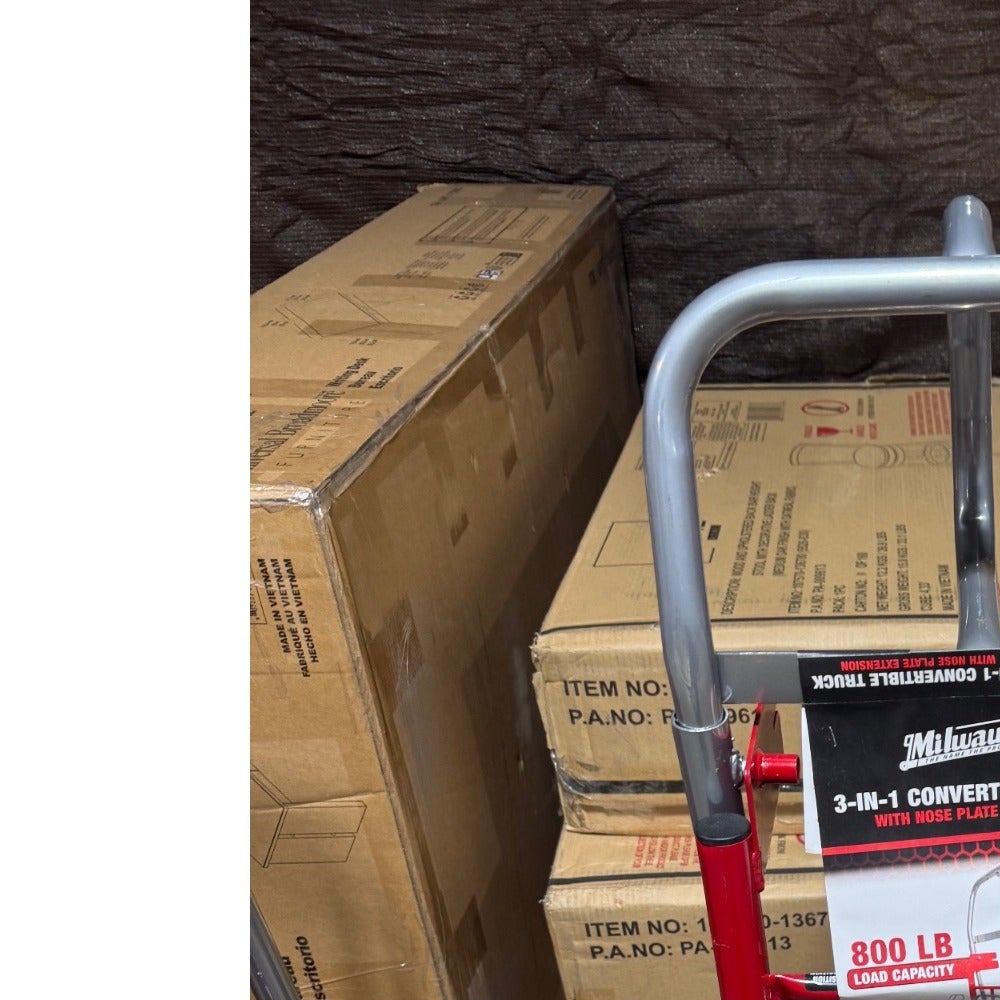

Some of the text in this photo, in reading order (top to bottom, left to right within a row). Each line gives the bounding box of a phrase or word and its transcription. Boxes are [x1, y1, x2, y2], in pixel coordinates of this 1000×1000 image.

[257, 558, 291, 653] MADE IN VIETNAM
[283, 558, 319, 662] HECHO EN VIETNAM
[270, 558, 310, 678] FABRIQUÉ AU VIETNAM
[840, 654, 996, 671] WITH NOSE PLATE EXTENSION
[811, 673, 866, 689] TRUCK
[869, 667, 977, 687] CONVERTIBLE
[563, 680, 669, 698] ITEM NO:
[568, 708, 653, 725] P.A.NO:
[833, 790, 899, 814] 3-IN-1
[874, 813, 911, 828] WITH
[915, 809, 953, 824] NOSE
[957, 806, 999, 821] PLATE
[584, 918, 689, 938] ITEM NO:
[590, 941, 673, 960] P.A.NO:
[851, 932, 953, 967] 800 LB
[853, 969, 889, 986] LOAD
[892, 962, 956, 982] CAPACITY
